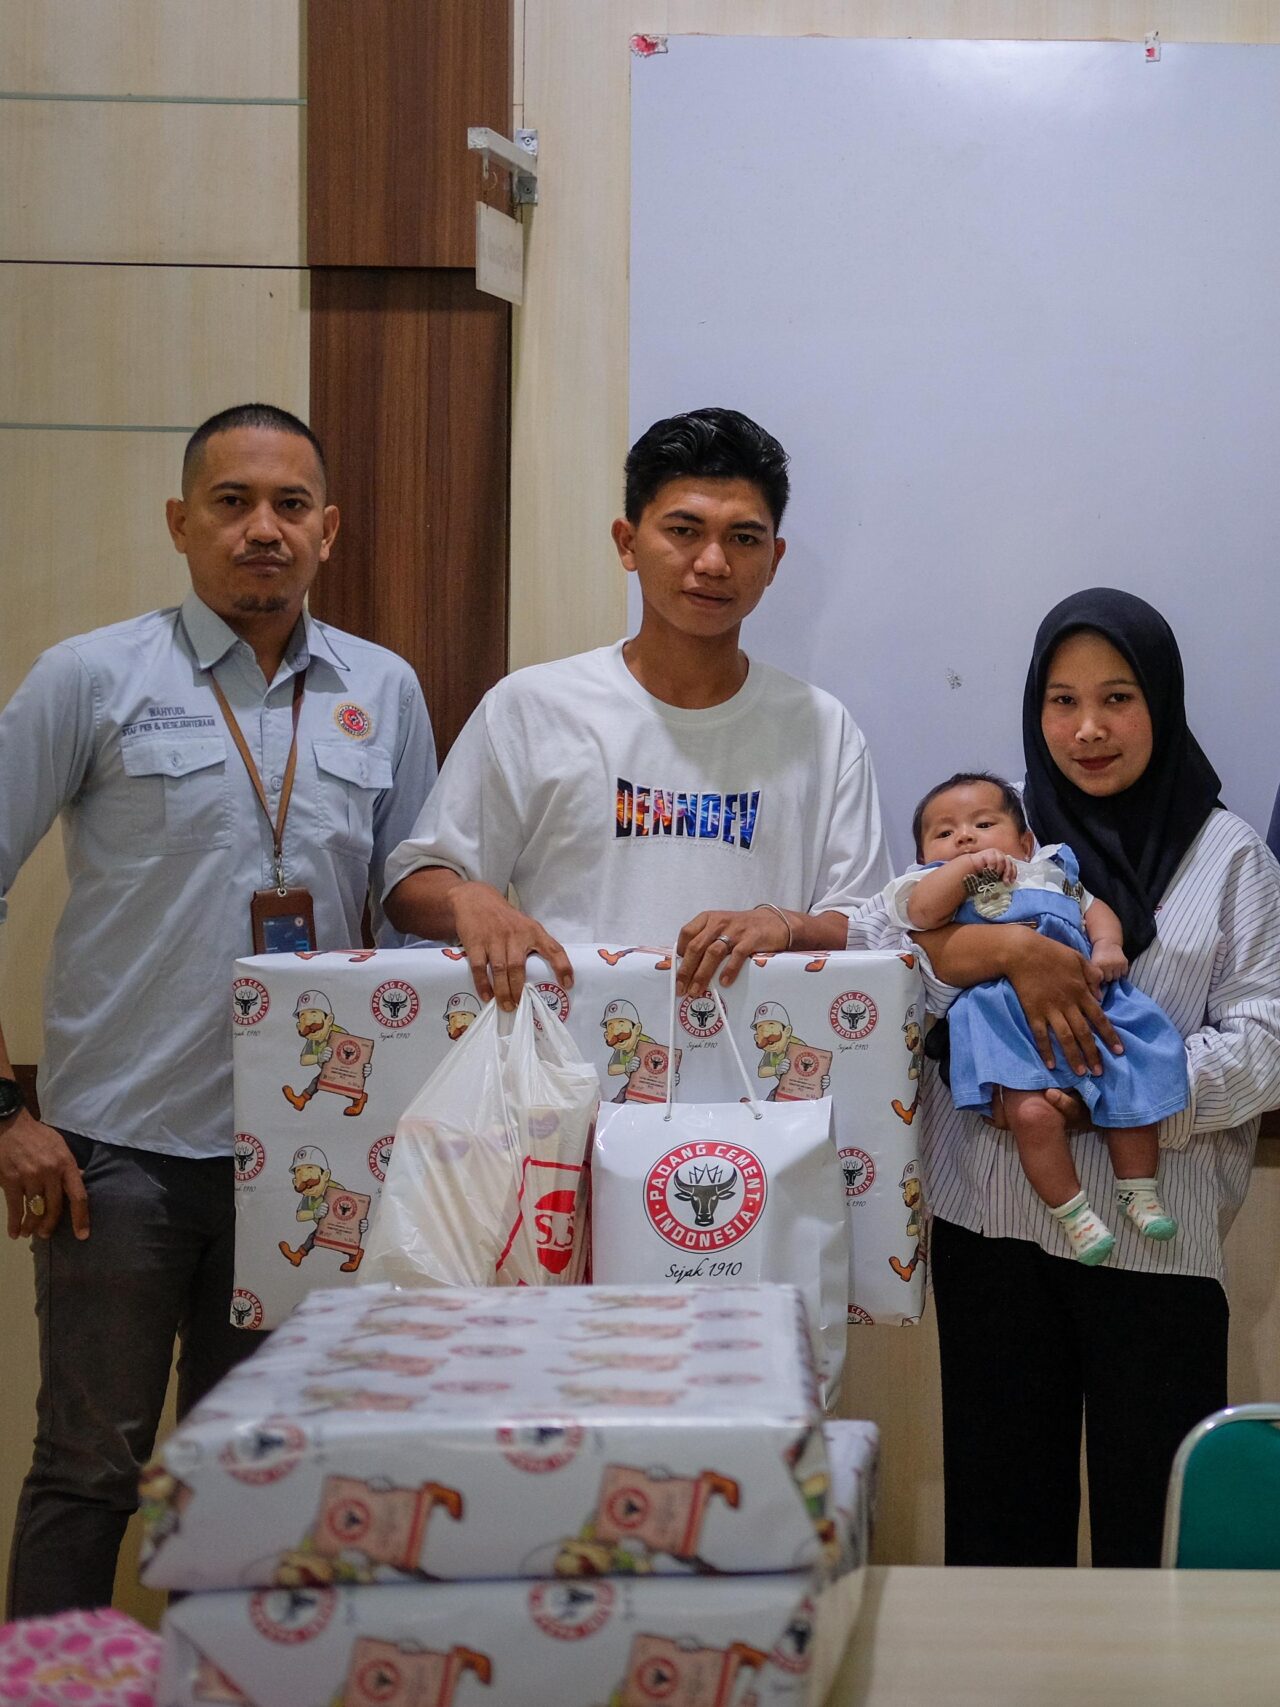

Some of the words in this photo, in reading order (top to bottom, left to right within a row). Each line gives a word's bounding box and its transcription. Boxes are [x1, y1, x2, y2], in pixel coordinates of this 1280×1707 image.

[616, 777, 761, 850] DENNDEV
[373, 982, 395, 1006] PADANG
[397, 982, 418, 1009] CEMENT
[548, 985, 568, 1013] CEMENT
[831, 993, 854, 1019] PADANG
[856, 993, 877, 1020] CEMENT
[375, 1011, 415, 1027] INDONESIA
[832, 1022, 874, 1039] INDONESIA
[370, 1137, 392, 1163] PADANG
[650, 1144, 706, 1200] PADANG
[714, 1146, 761, 1201] CEMENT
[655, 1210, 754, 1247] INDONESIA
[664, 1257, 709, 1284] Sejak
[709, 1261, 743, 1277] 1910
